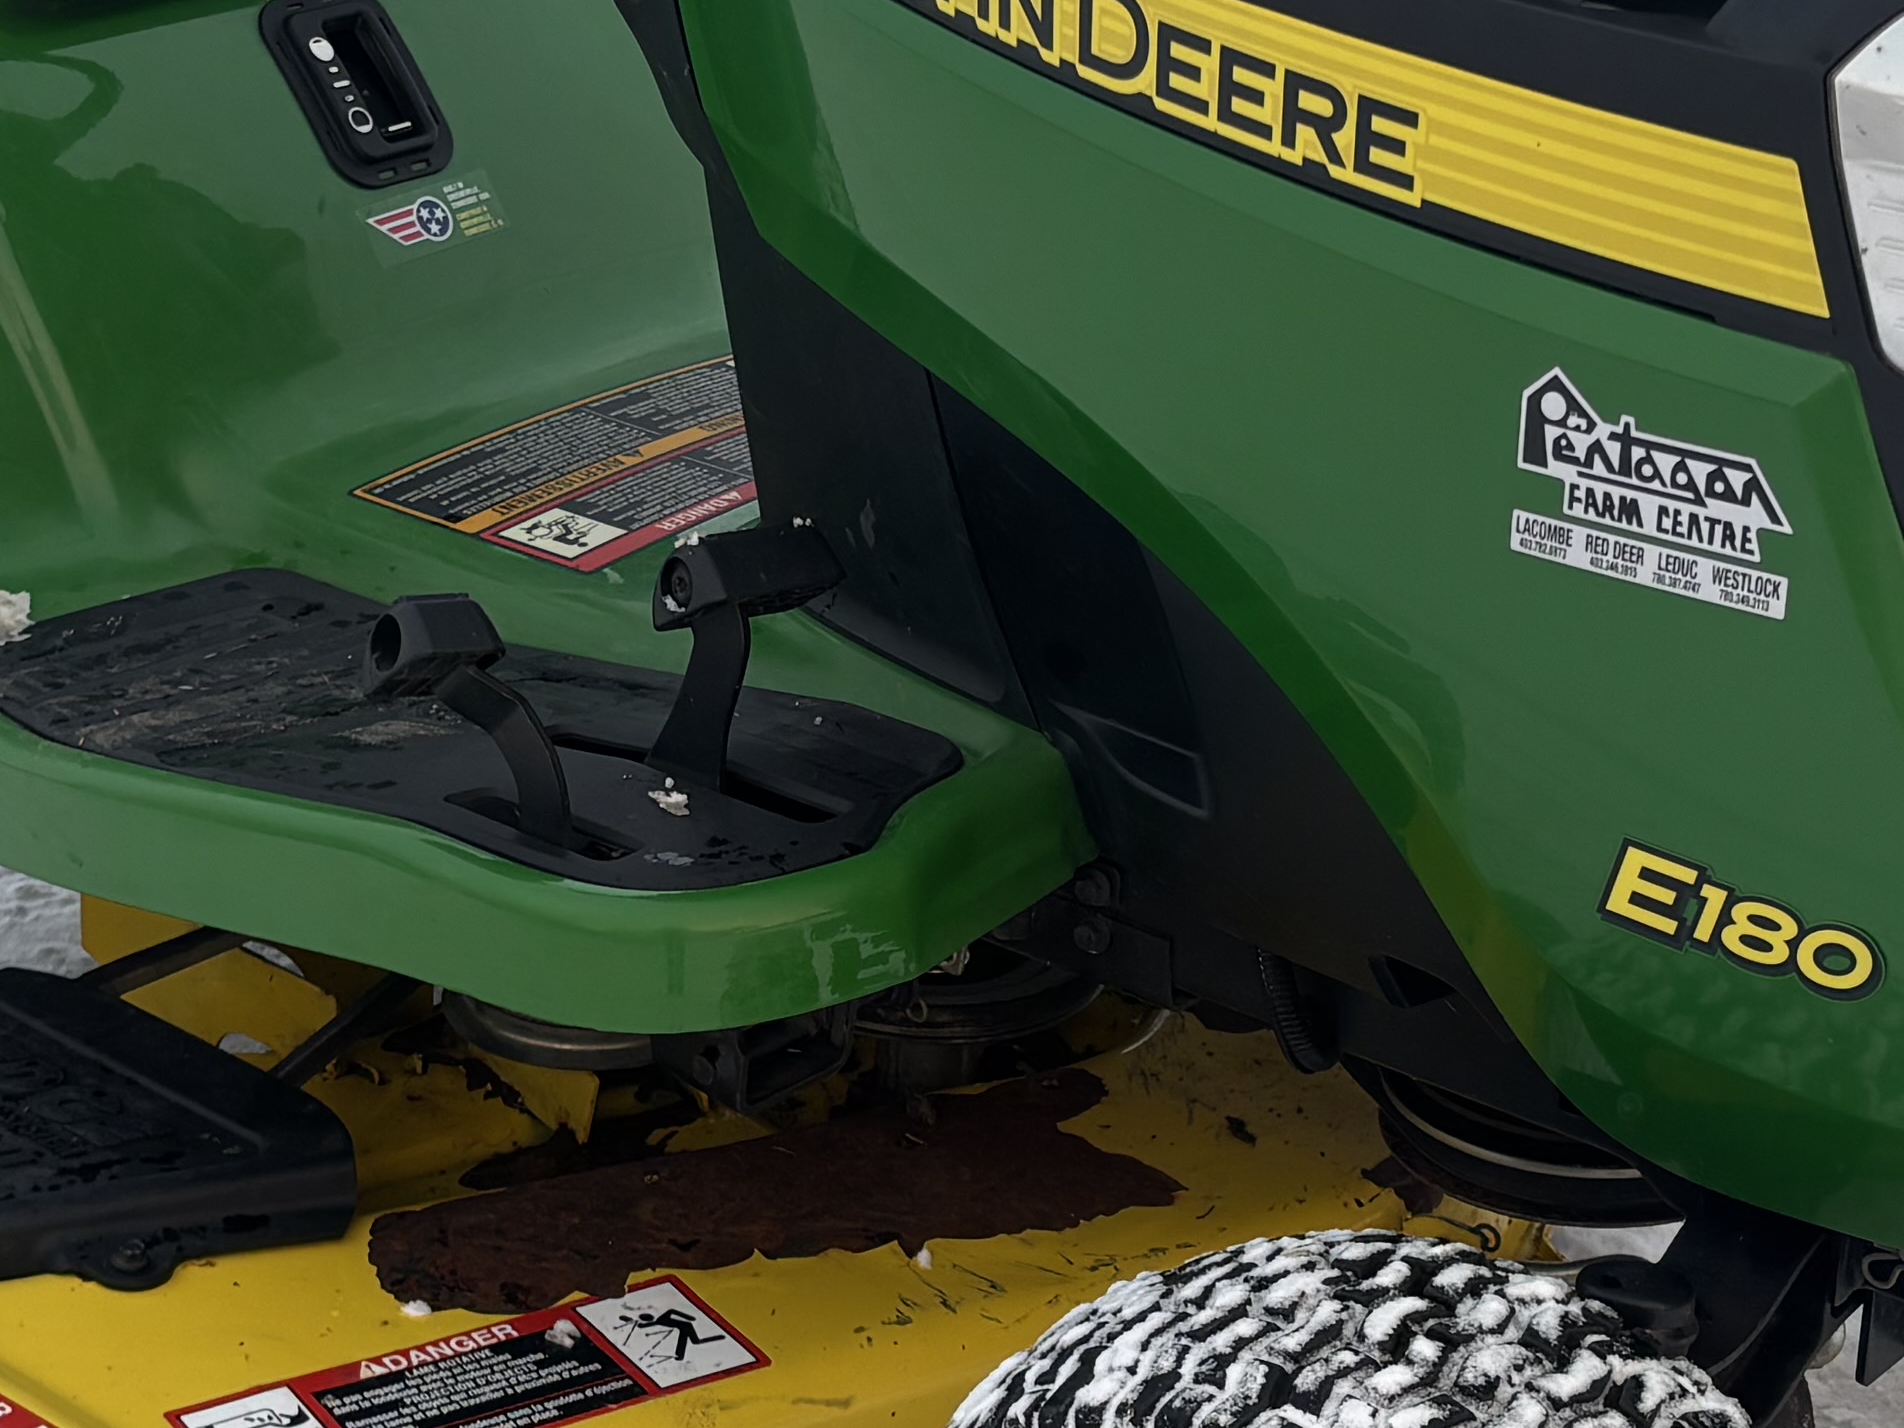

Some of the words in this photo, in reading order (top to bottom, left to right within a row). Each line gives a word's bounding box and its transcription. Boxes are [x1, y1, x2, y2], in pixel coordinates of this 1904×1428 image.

[1521, 372, 1785, 528] Pentagon
[491, 458, 626, 517] AVERTISSEMENT
[654, 497, 725, 532] DANGER
[1515, 515, 1574, 548] LACOMBE
[1566, 482, 1644, 529] FARM
[1655, 504, 1757, 557] CENTRE
[1585, 534, 1610, 557] RED
[1613, 541, 1645, 566] DEER
[1657, 552, 1698, 580] LEDUC
[1712, 564, 1782, 601] WESTLOCK
[1604, 845, 1874, 990] E180
[380, 1323, 519, 1370] DANGER
[404, 1364, 437, 1377] LAME
[437, 1349, 493, 1368] ROTATIVE
[403, 1380, 474, 1404] PROJECTION
